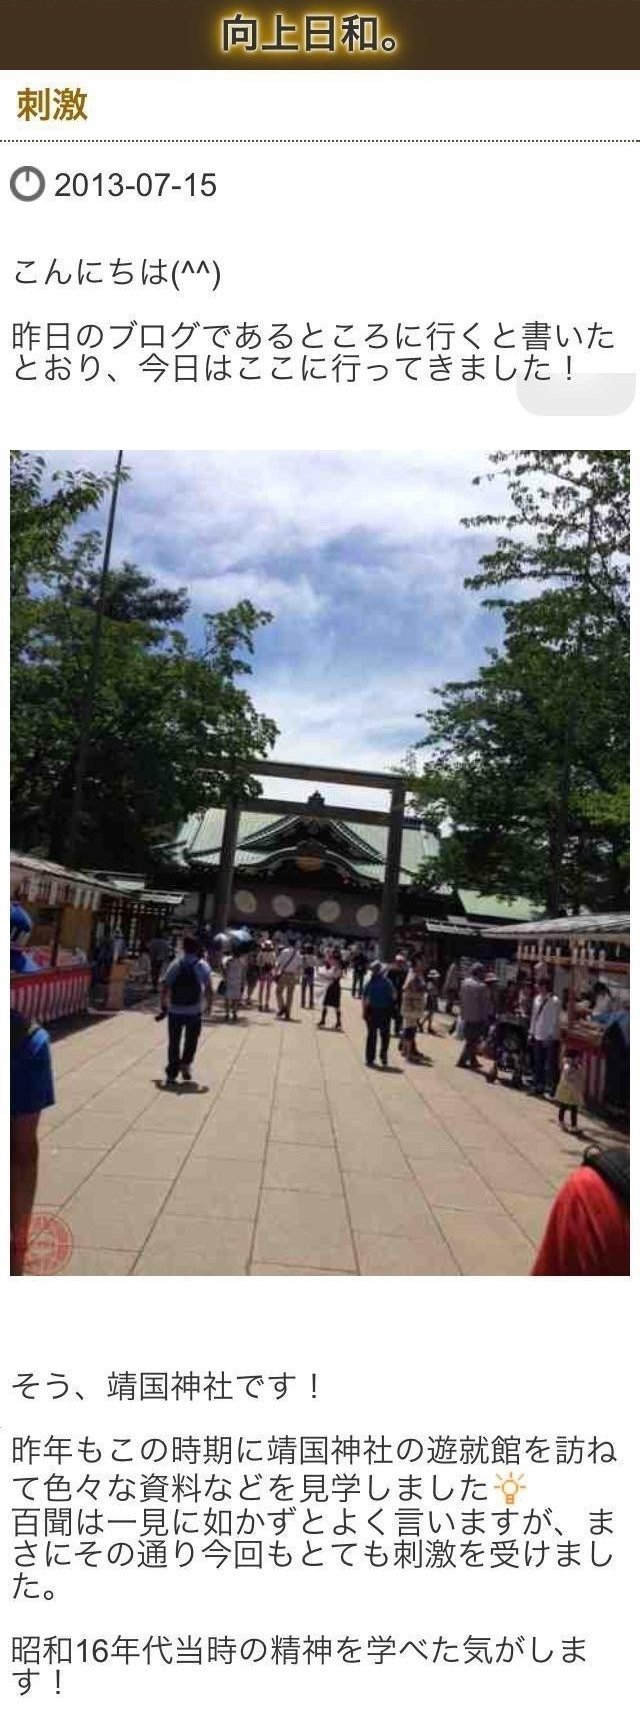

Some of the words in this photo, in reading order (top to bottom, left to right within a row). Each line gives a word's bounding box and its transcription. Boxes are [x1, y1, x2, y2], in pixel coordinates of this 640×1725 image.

[220, 13, 400, 54] 向上日和。
[16, 87, 88, 122] 刺激
[54, 171, 218, 199] 2013-07-15
[14, 257, 221, 291] こんにちは(^^)
[11, 319, 615, 351] 昨日のブログであるところに行くと書いた
[14, 353, 574, 383] とおり、今日はここに行ってきました！
[11, 1370, 318, 1401] そう、靖国神社です！
[11, 1435, 617, 1466] 昨年もこの時期に靖国神社の遊就館を訪ね
[12, 1473, 488, 1504] て色々な資料などを見学しました
[11, 1507, 614, 1537] 百聞は一見に如かずとよく言いますが、ま
[14, 1539, 613, 1569] さにその通り今回もとても刺激を受けまし
[12, 1571, 55, 1601] た。
[11, 1635, 587, 1666] 昭和16年代当時の精神を学べた気がしま
[12, 1667, 61, 1697] す！
